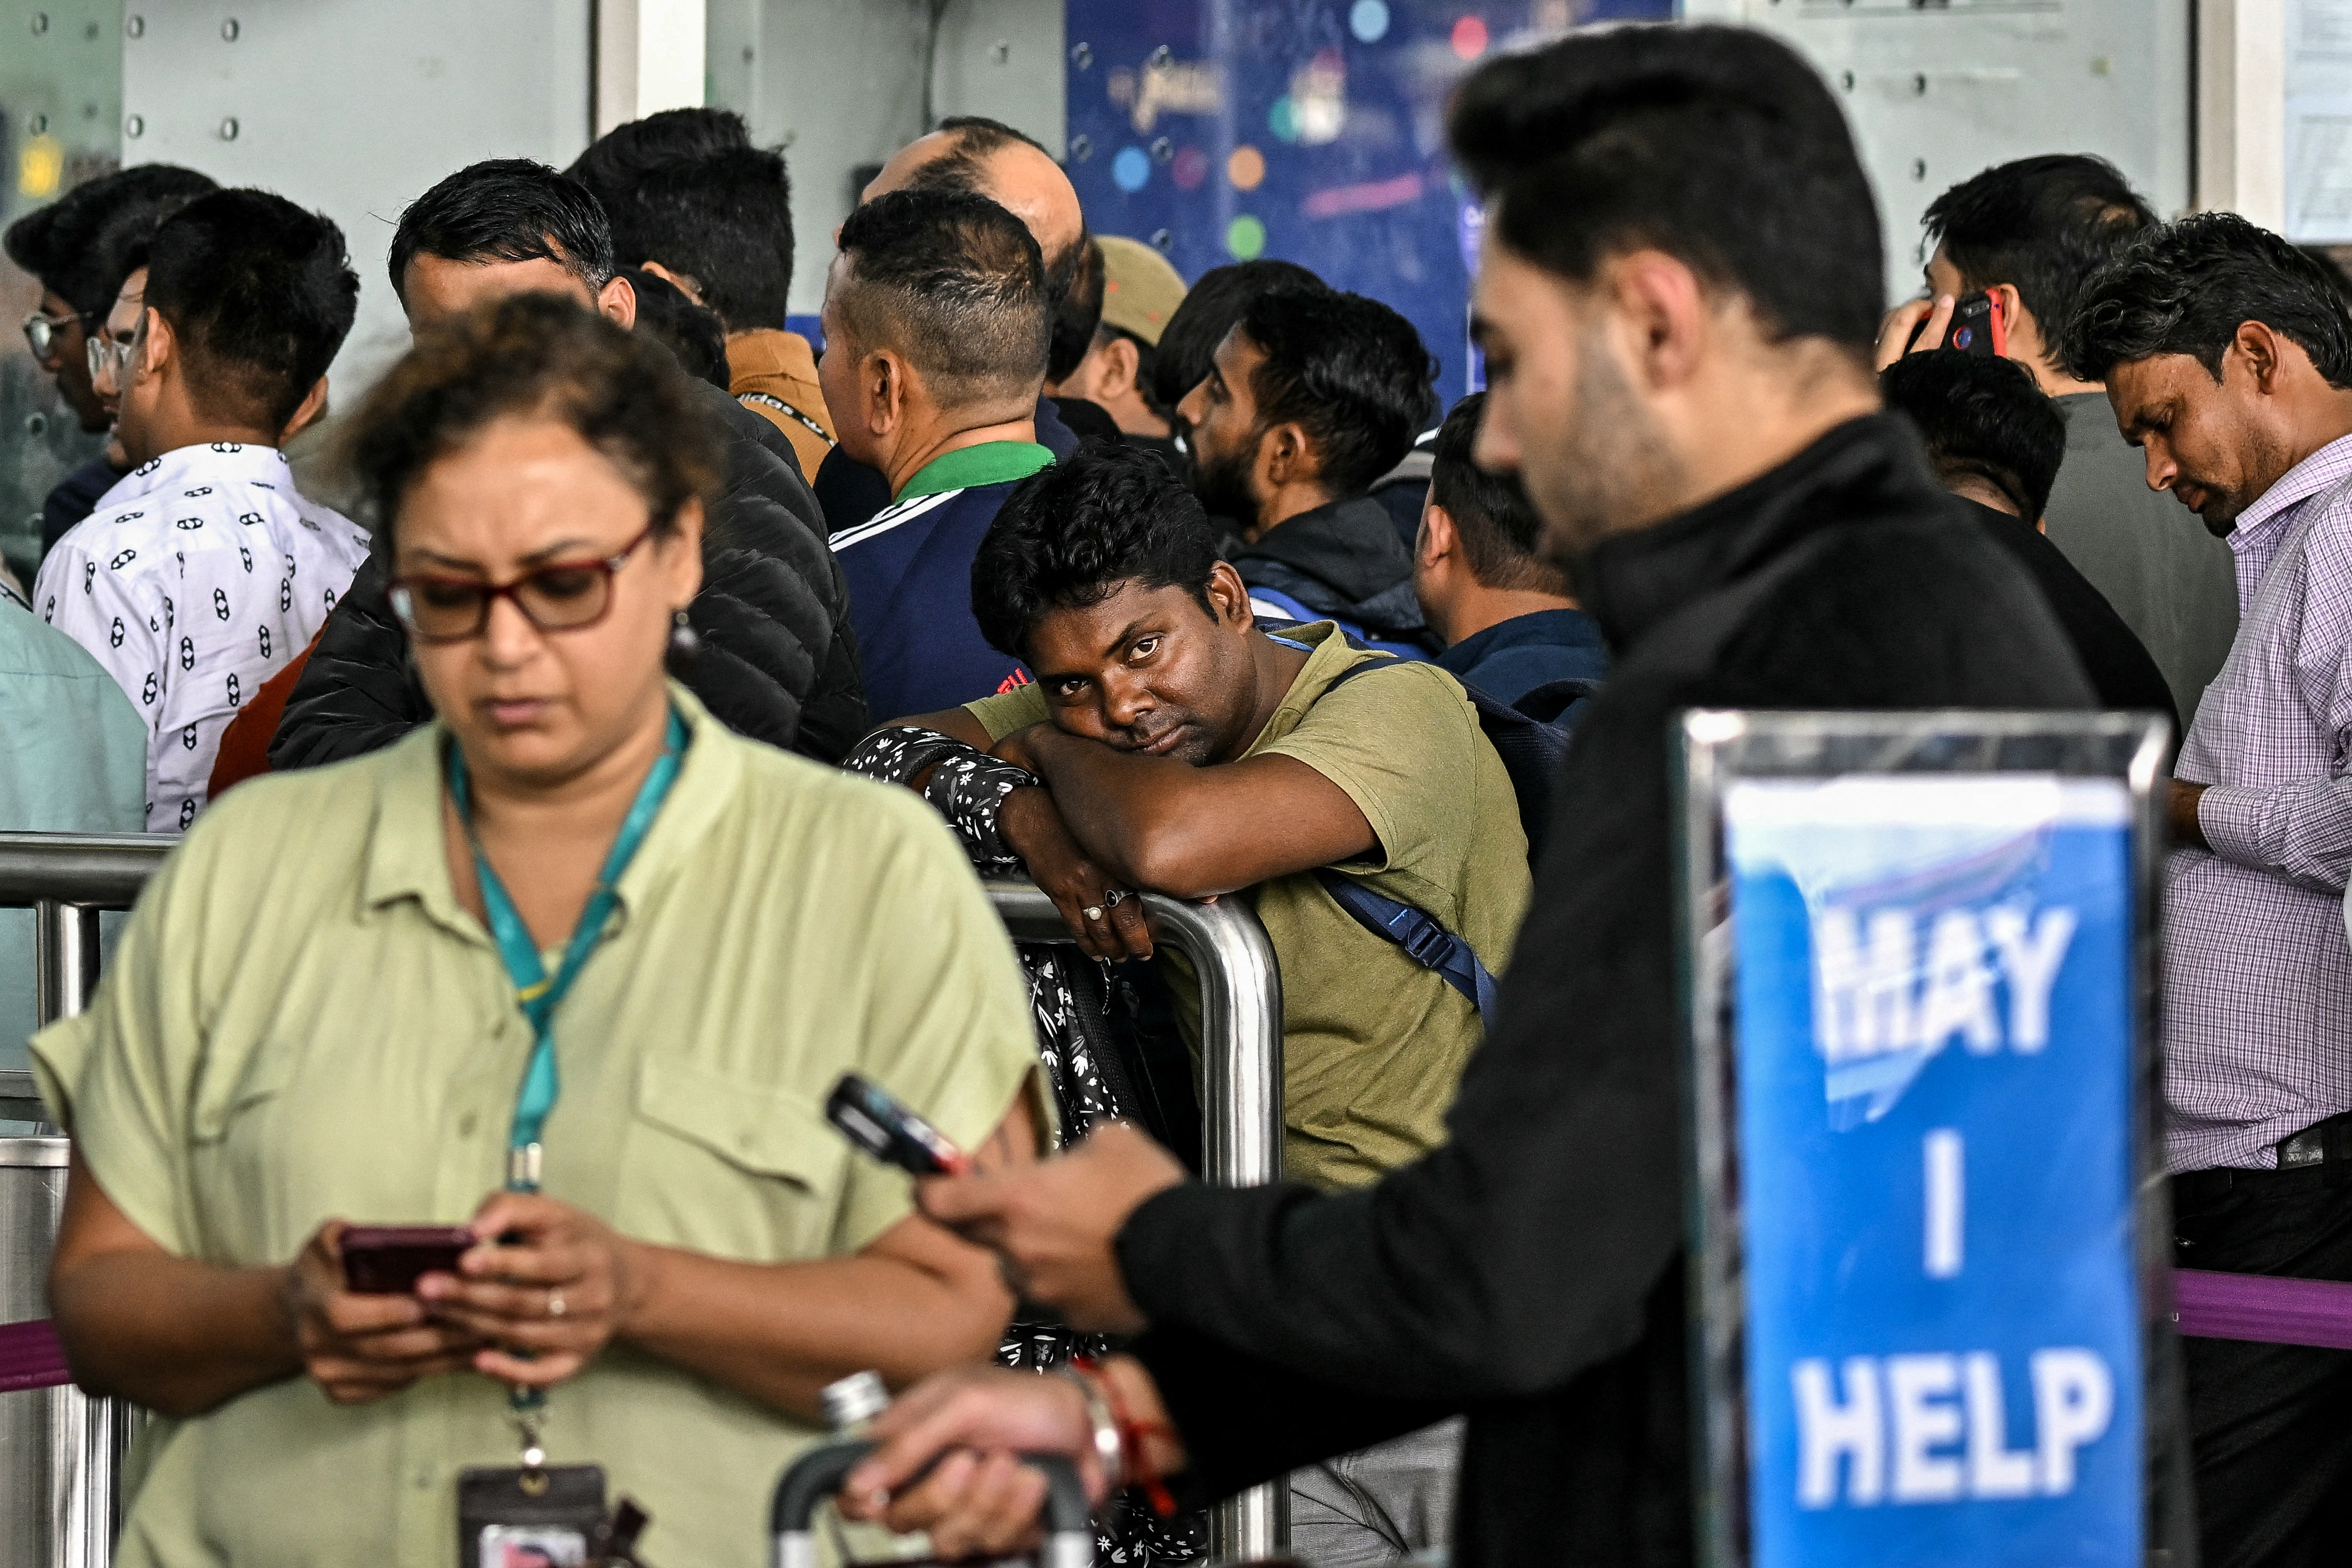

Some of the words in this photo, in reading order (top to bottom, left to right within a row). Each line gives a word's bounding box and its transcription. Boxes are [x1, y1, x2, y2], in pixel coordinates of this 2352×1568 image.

[736, 392, 794, 416] idas
[1813, 907, 2076, 1055] MAY
[1926, 1131, 1961, 1274] I
[1794, 1350, 2112, 1505] HELP
